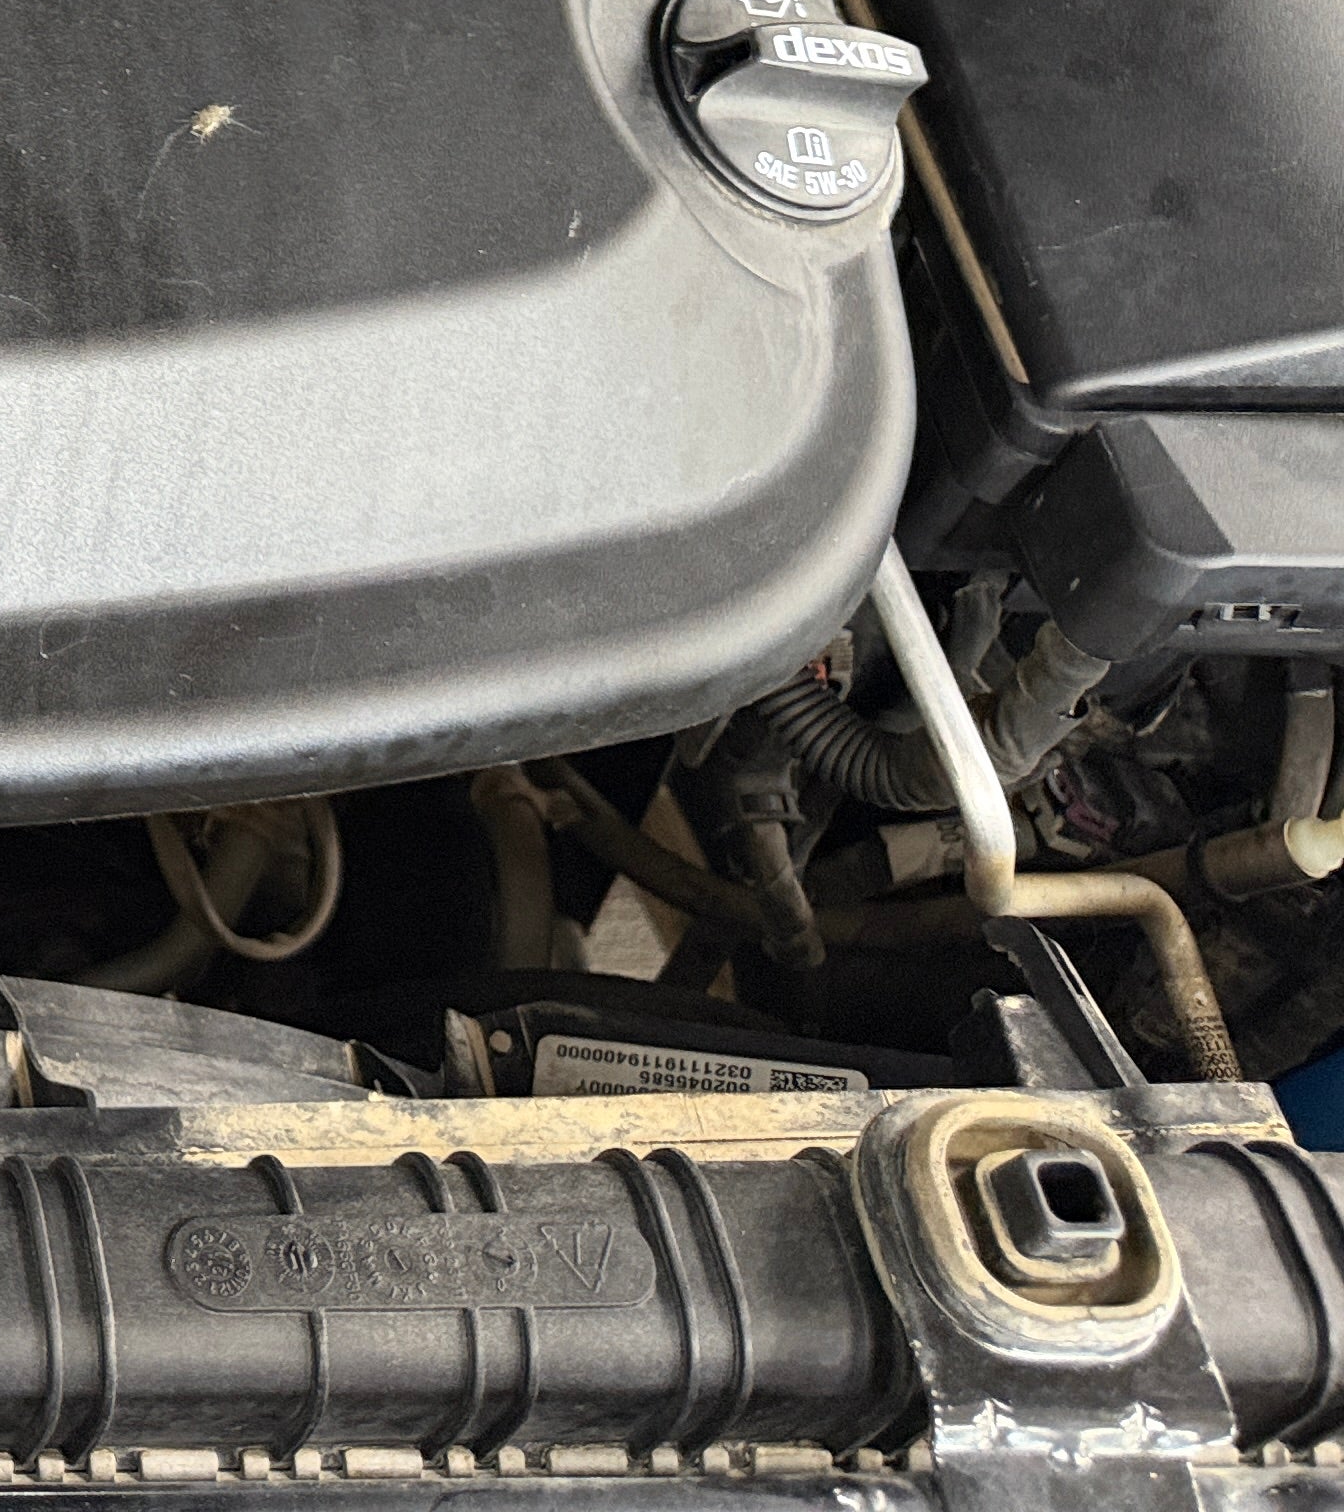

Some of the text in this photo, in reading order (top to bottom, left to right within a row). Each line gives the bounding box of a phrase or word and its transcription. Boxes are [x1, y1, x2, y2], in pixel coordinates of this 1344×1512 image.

[773, 27, 912, 76] dexos
[754, 151, 867, 195] SAE 5W-30
